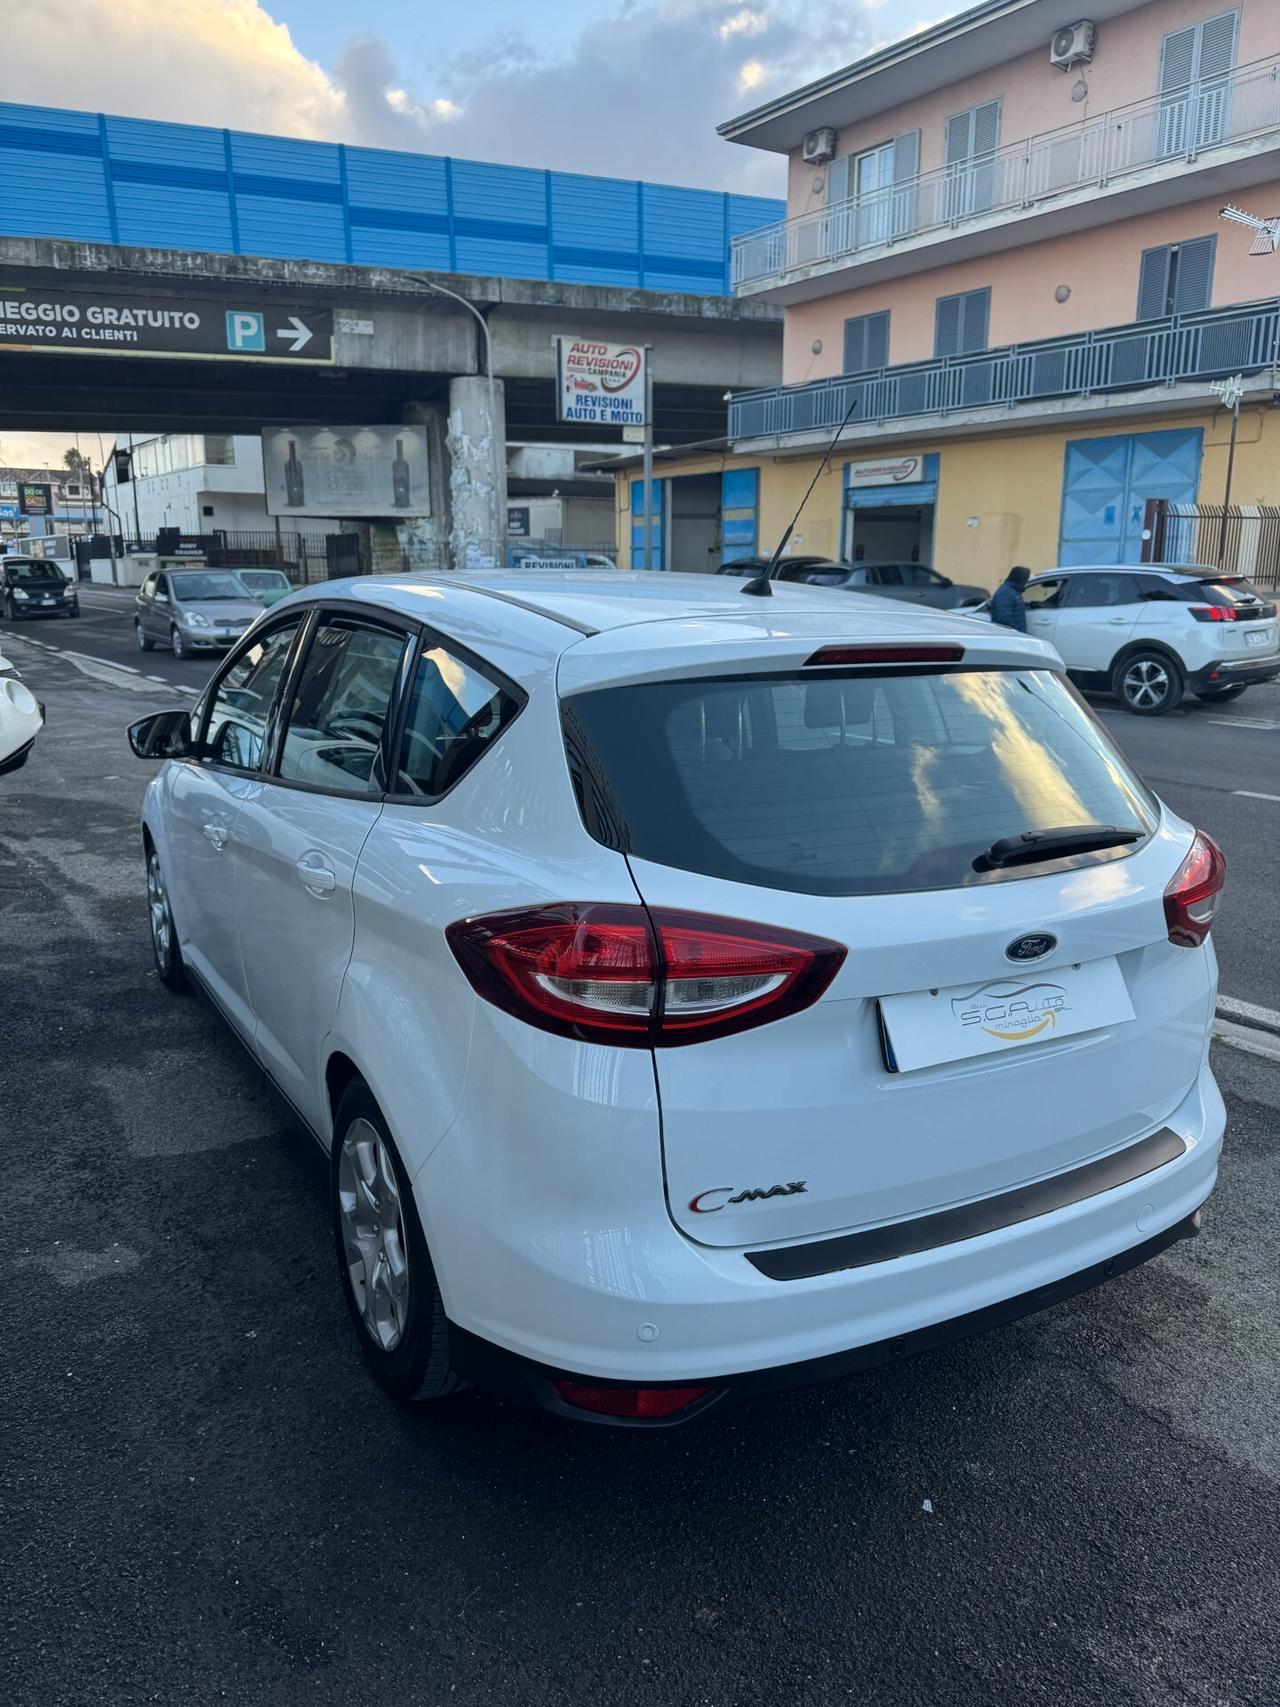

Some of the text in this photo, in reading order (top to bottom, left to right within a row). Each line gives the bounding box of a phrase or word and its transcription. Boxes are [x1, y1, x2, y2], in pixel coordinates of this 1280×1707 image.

[86, 306, 200, 329] GRATUITO
[61, 327, 77, 338] AI
[81, 328, 137, 341] CLIENTI
[233, 314, 258, 347] P
[570, 342, 607, 355] AUTO
[567, 355, 633, 371] REVISIONI
[575, 394, 633, 410] REVISIONI
[566, 407, 642, 423] AUTO E MOTO
[1018, 938, 1047, 957] Ford
